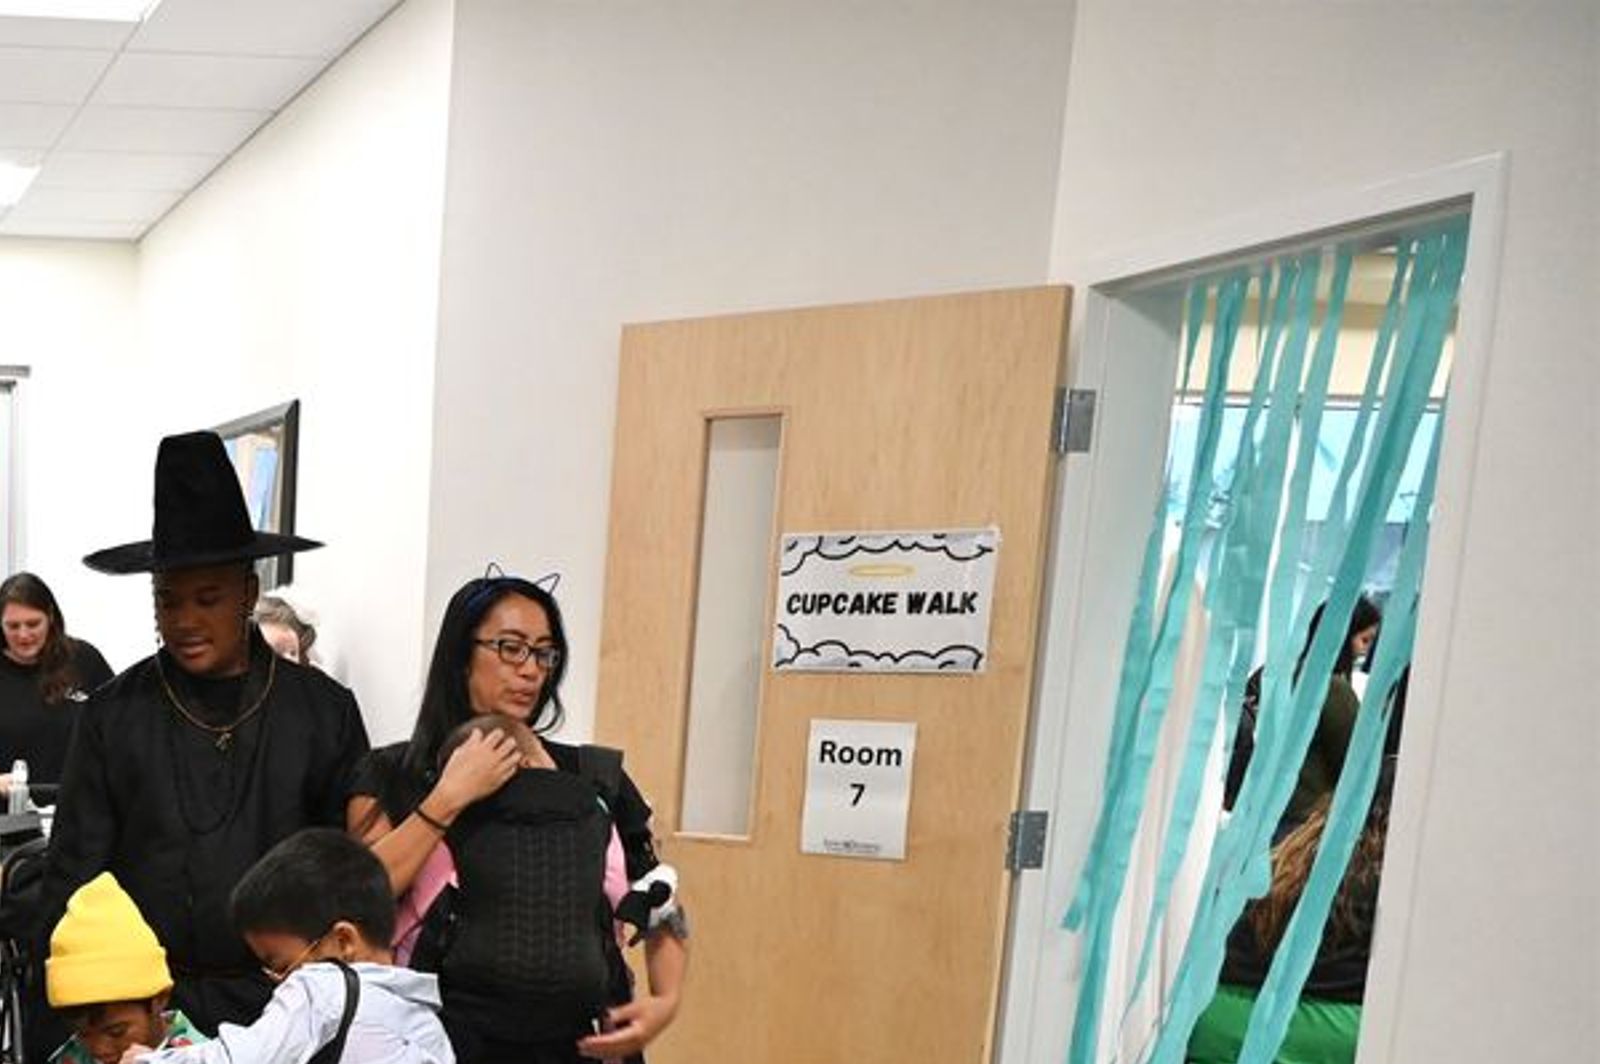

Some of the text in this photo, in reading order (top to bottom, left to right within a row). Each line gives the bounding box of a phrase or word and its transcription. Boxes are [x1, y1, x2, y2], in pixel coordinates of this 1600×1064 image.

[786, 591, 979, 615] CUPCAKE WALK
[818, 740, 902, 767] Room
[849, 783, 866, 807] 7
